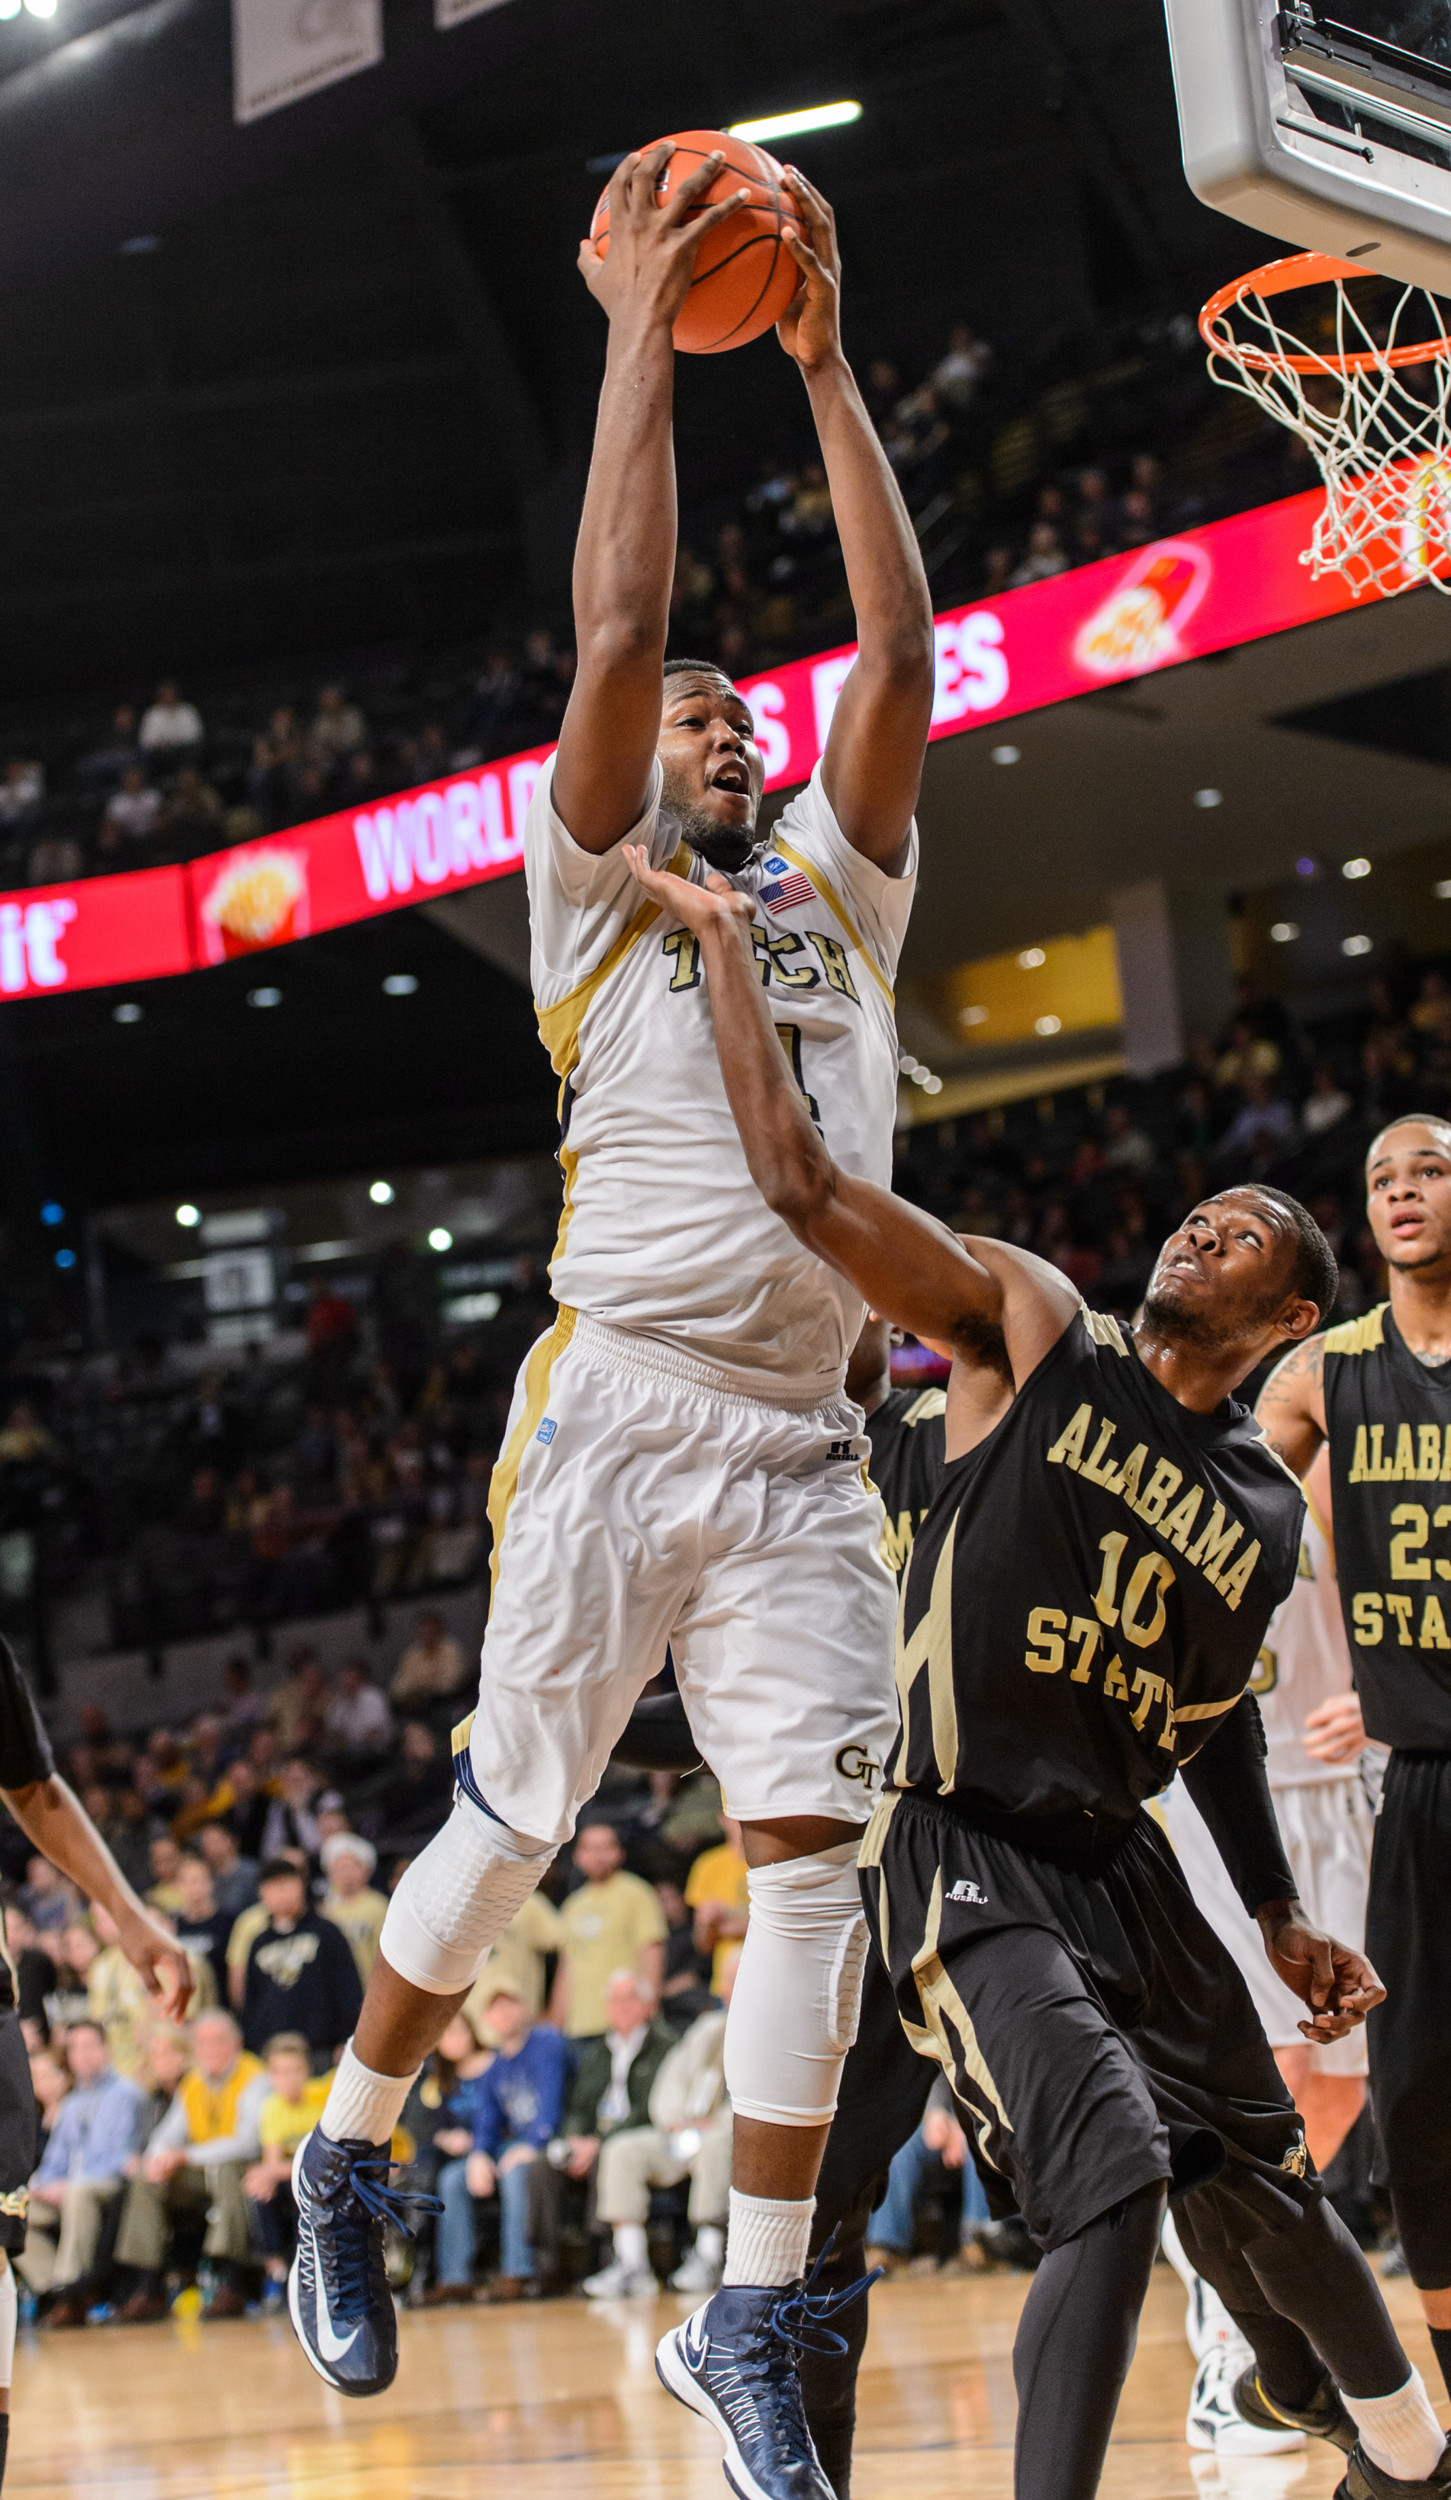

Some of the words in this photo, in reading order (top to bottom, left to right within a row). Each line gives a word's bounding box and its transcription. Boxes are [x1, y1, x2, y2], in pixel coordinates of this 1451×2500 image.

[1046, 1403, 1262, 1612] ALABAMA
[1089, 1530, 1177, 1649] 10
[834, 1744, 880, 1791] GT
